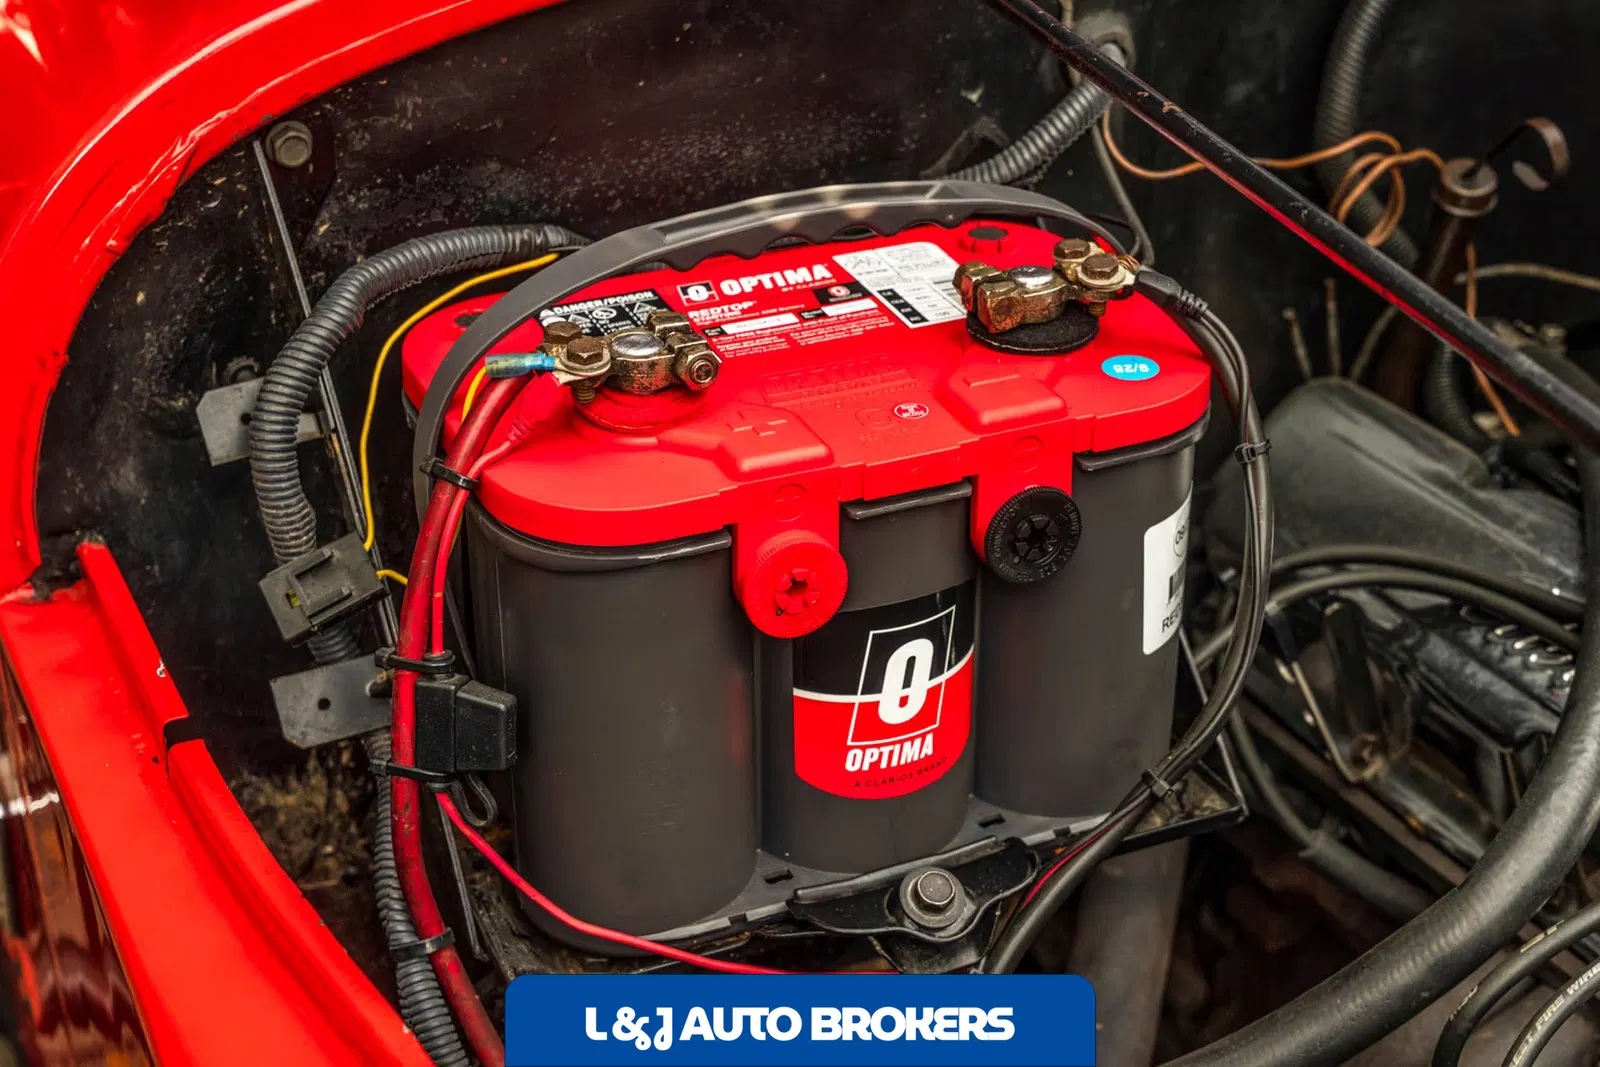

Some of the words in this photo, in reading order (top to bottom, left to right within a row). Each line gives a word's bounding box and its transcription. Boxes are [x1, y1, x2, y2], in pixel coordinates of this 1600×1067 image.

[720, 264, 833, 295] OPTIMA
[553, 291, 654, 315] DANGER/POISON
[687, 301, 753, 319] REDTOP
[844, 733, 934, 772] OPTIMA
[865, 772, 914, 788] CLARIOS
[917, 757, 949, 777] BRAND
[1535, 994, 1565, 1031] FIRE
